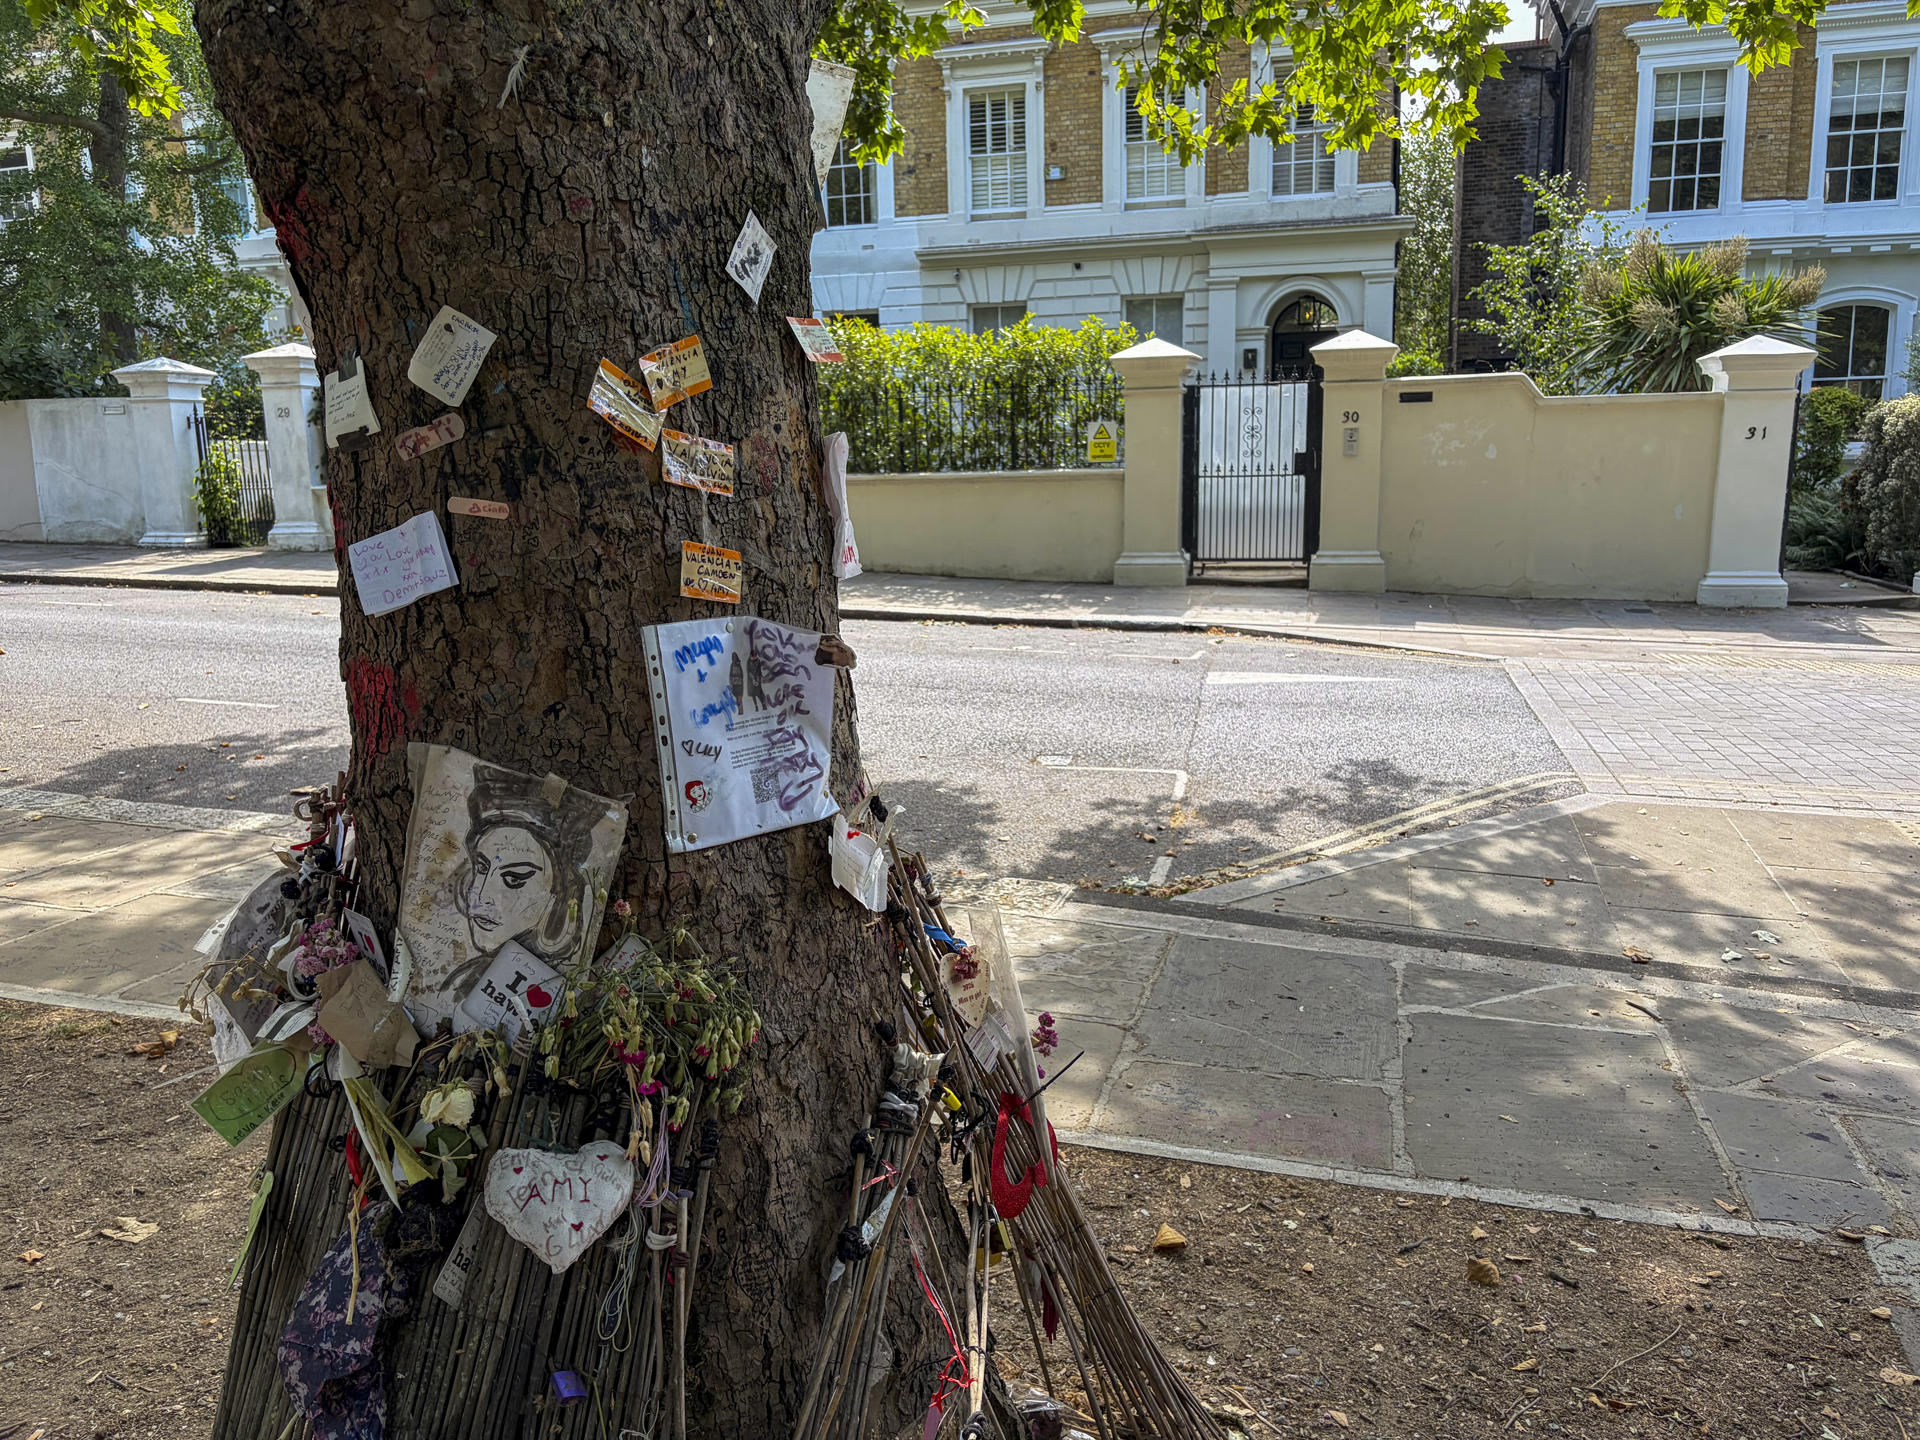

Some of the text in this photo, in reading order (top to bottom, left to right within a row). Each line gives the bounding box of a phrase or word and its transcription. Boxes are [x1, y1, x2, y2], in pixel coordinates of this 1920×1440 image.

[277, 407, 290, 418] 29
[1342, 411, 1360, 423] 30
[1745, 426, 1767, 440] 31
[685, 550, 732, 571] VALENCIA
[697, 565, 736, 580] CAMDEN
[519, 1176, 592, 1213] AMY
